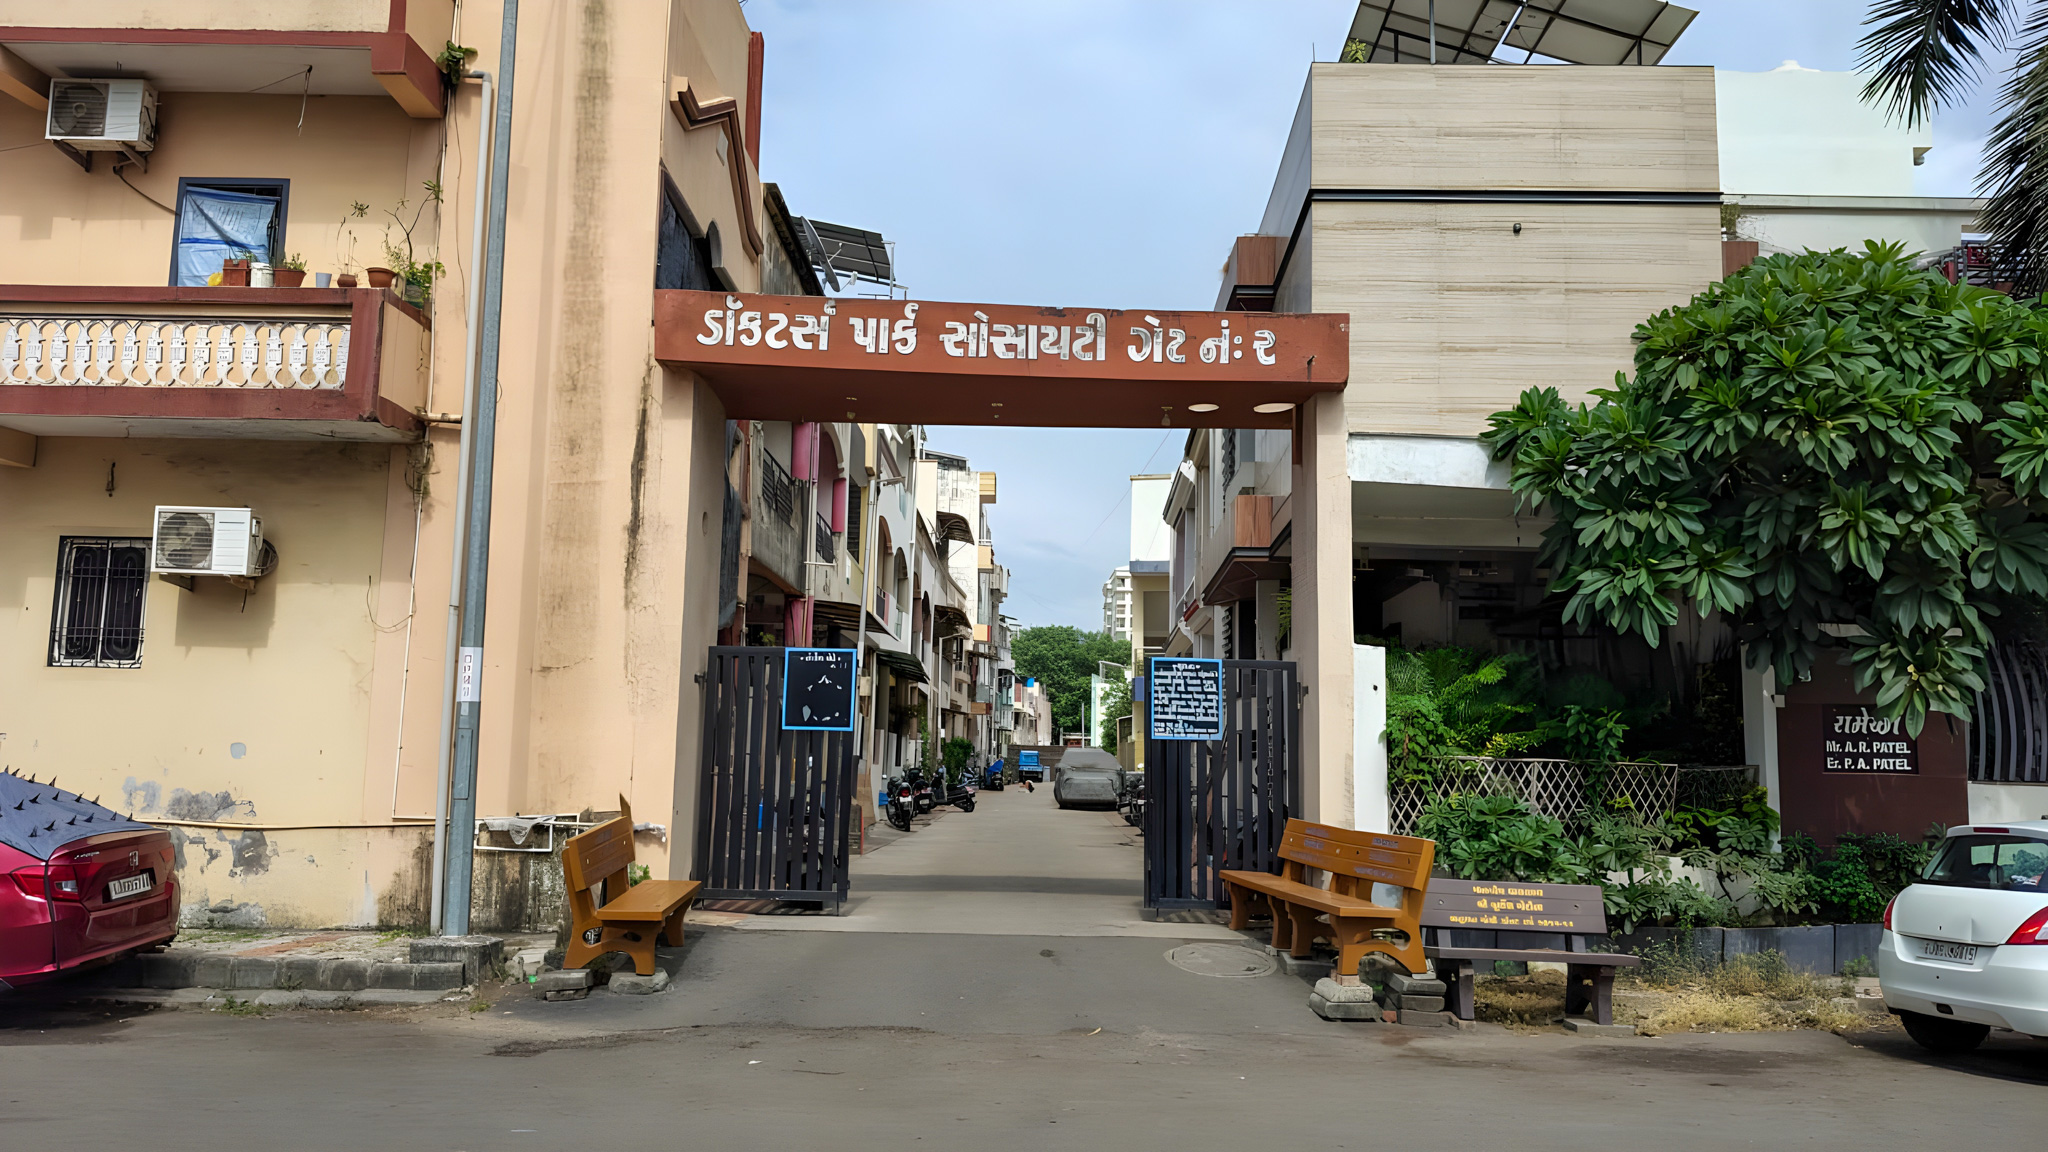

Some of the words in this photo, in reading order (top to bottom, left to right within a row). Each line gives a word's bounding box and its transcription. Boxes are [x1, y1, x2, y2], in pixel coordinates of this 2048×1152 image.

[849, 303, 920, 354] પાર્ક
[939, 310, 1107, 361] સોસાયટી
[1873, 742, 1911, 754] PATEL
[1873, 758, 1912, 770] PATEL
